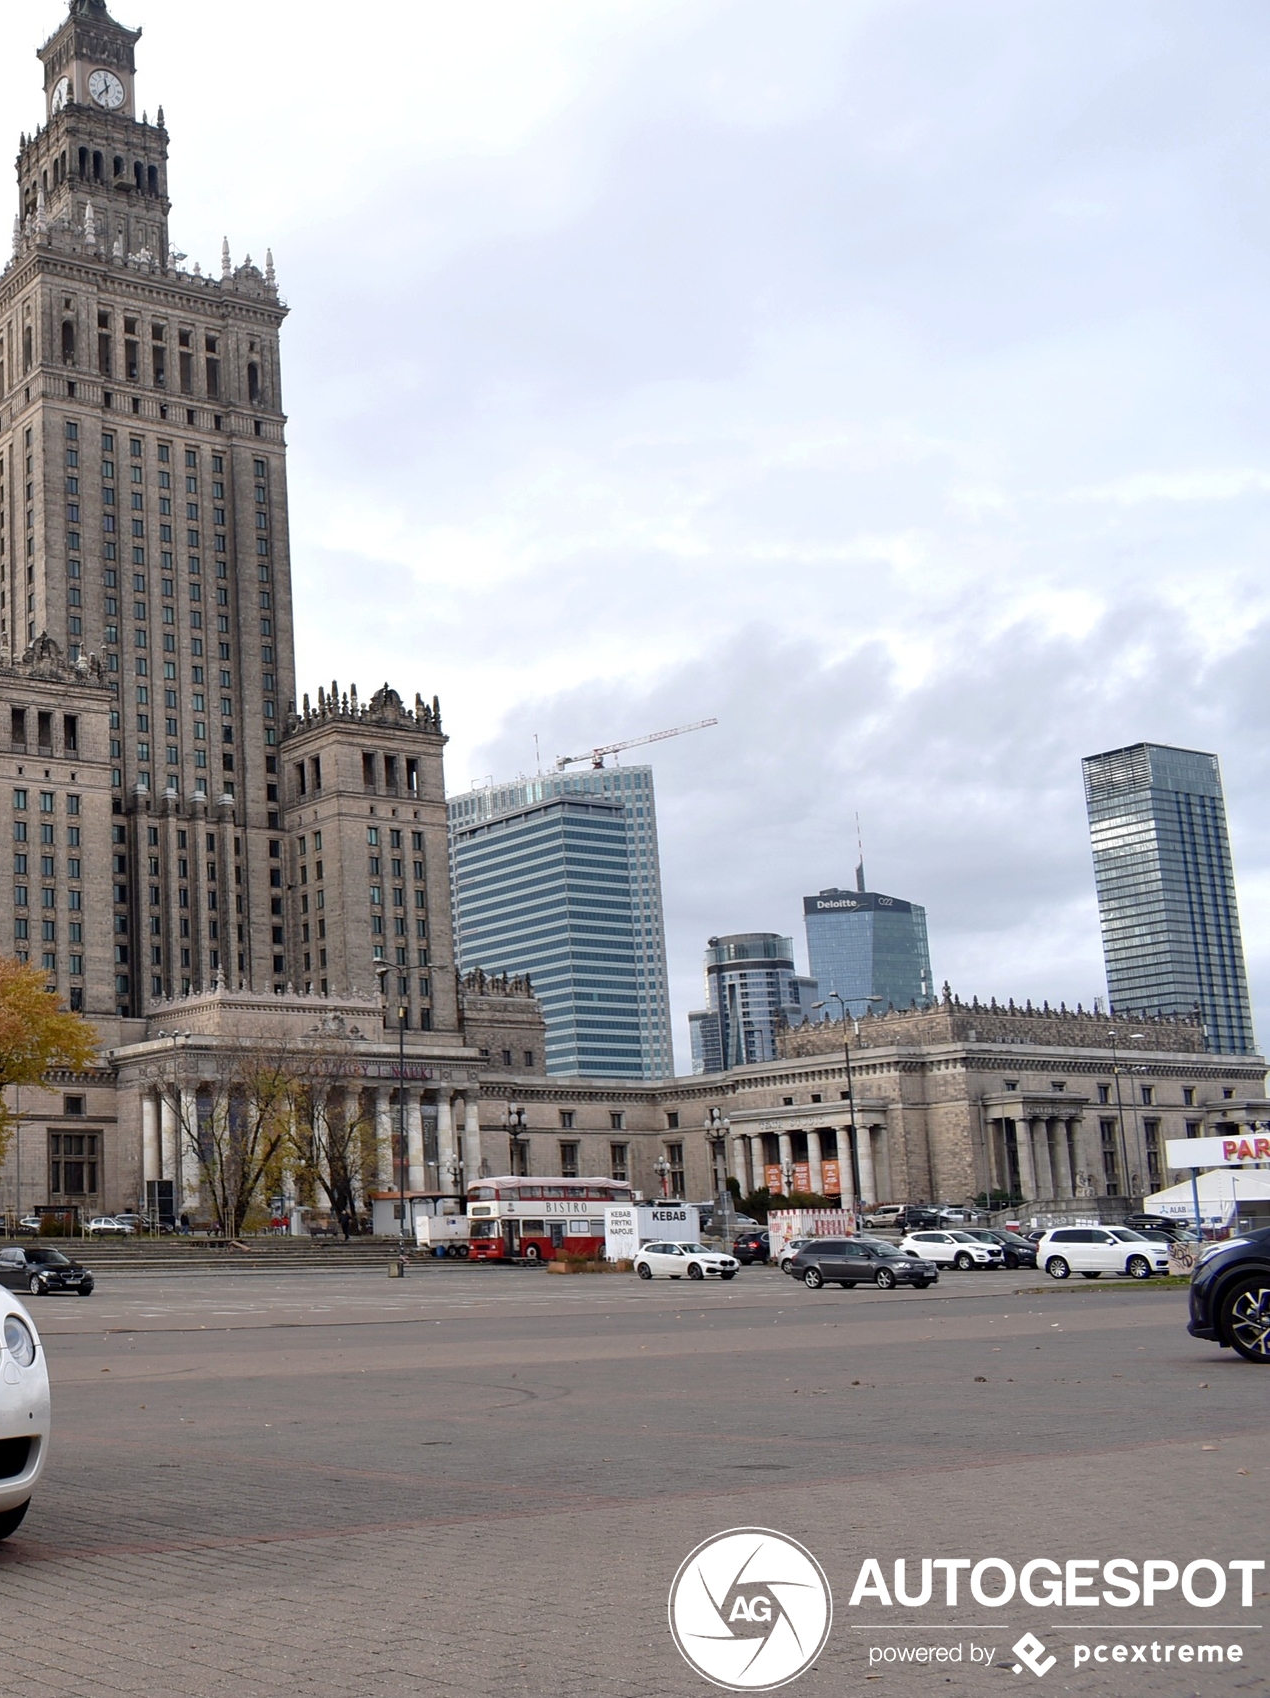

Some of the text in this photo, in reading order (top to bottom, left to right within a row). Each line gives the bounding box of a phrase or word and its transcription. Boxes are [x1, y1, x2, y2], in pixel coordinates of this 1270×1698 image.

[816, 899, 857, 909] Deloitte
[790, 1115, 825, 1128] STUDIO
[546, 1202, 587, 1213] BISTRO
[652, 1211, 687, 1221] KEBAB
